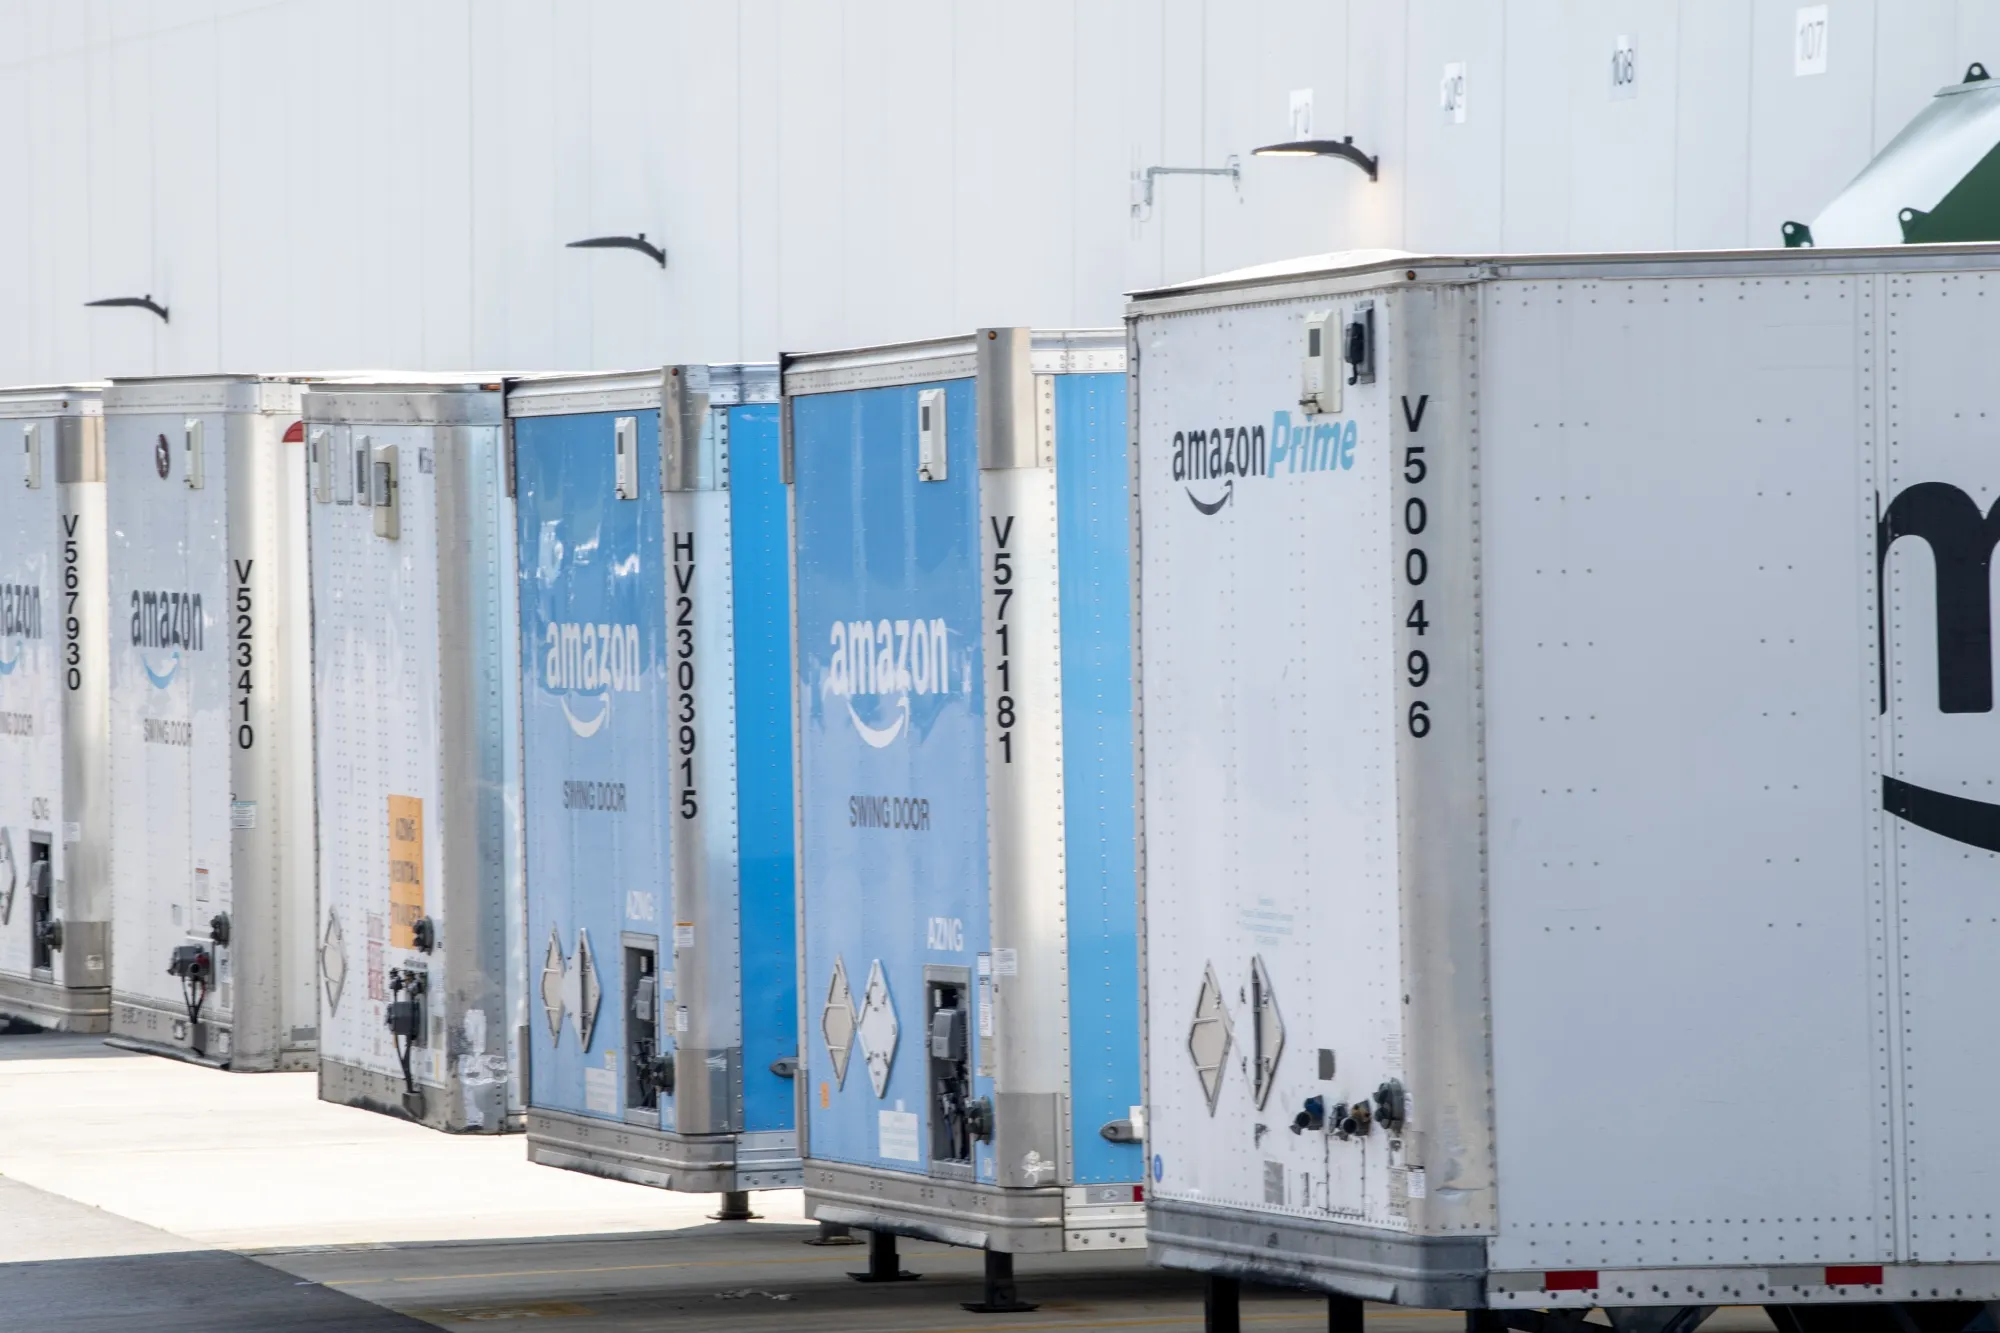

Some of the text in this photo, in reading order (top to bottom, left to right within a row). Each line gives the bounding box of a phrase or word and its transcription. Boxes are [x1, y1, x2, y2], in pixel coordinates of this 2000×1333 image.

[1612, 47, 1634, 86] 108
[1800, 20, 1824, 61] 107
[1172, 410, 1358, 481] amazon Prime
[1402, 394, 1431, 738] V500496
[62, 514, 81, 691] V567930
[131, 589, 204, 651] amazon
[234, 559, 254, 750] V523410
[545, 621, 641, 692] amazon
[829, 616, 949, 696] amazon
[990, 515, 1016, 763] V571181
[673, 531, 698, 820] HV2303915
[849, 795, 931, 831] SWING DOOR
[926, 916, 964, 952] AZNG
